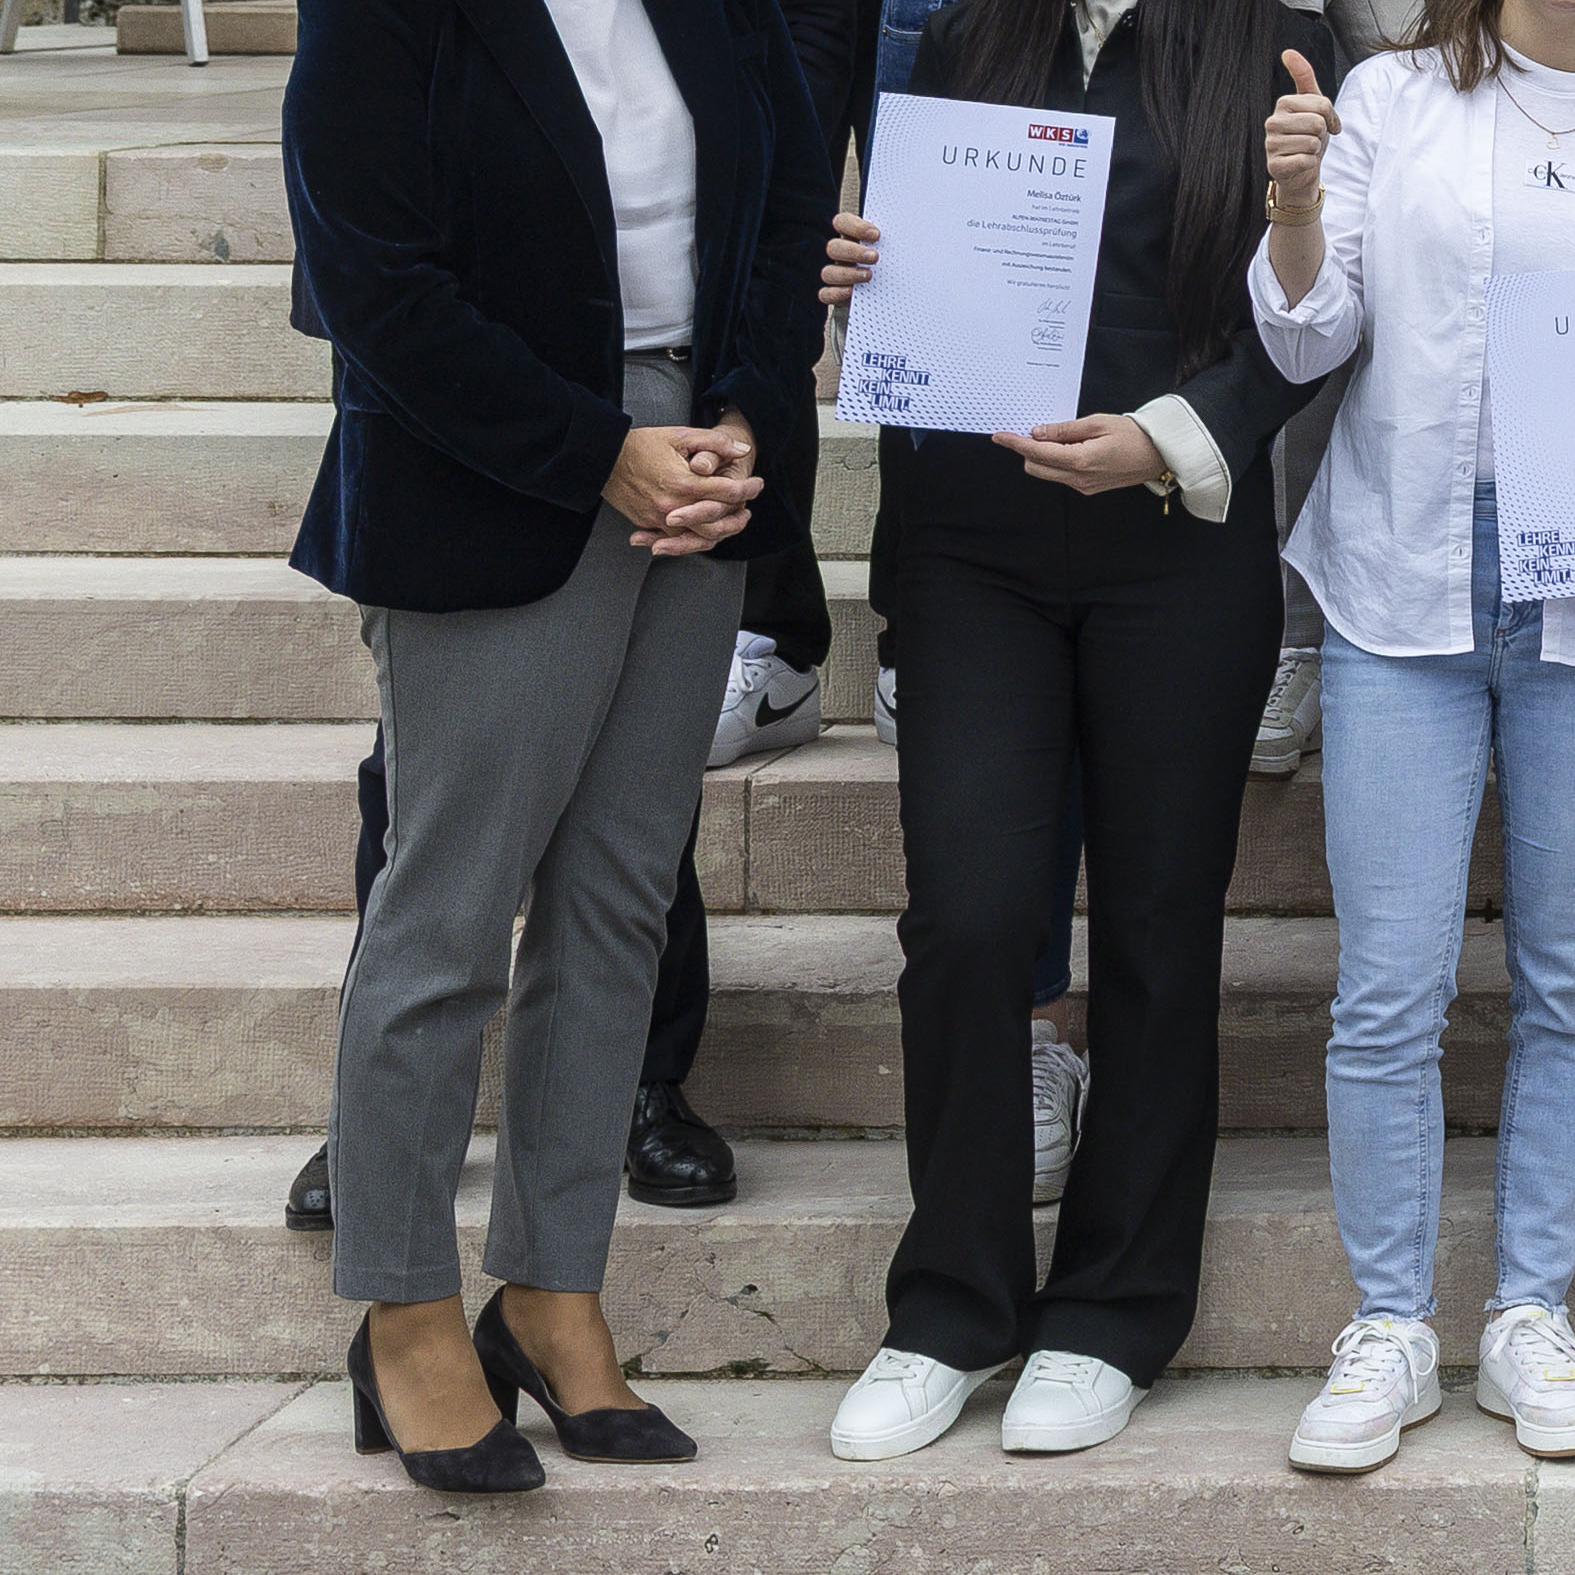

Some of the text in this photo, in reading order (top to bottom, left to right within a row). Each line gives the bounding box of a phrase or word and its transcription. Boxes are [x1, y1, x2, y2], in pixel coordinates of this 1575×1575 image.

[1028, 125, 1072, 142] WKS
[942, 144, 1087, 178] URKUNDE
[1026, 188, 1082, 203] Melisa Öztürk
[861, 352, 907, 369] LEHRE
[881, 368, 930, 385] KENNT
[858, 379, 891, 395] KEIN
[1517, 530, 1560, 546] LEHRE
[1518, 557, 1550, 573] KEIN
